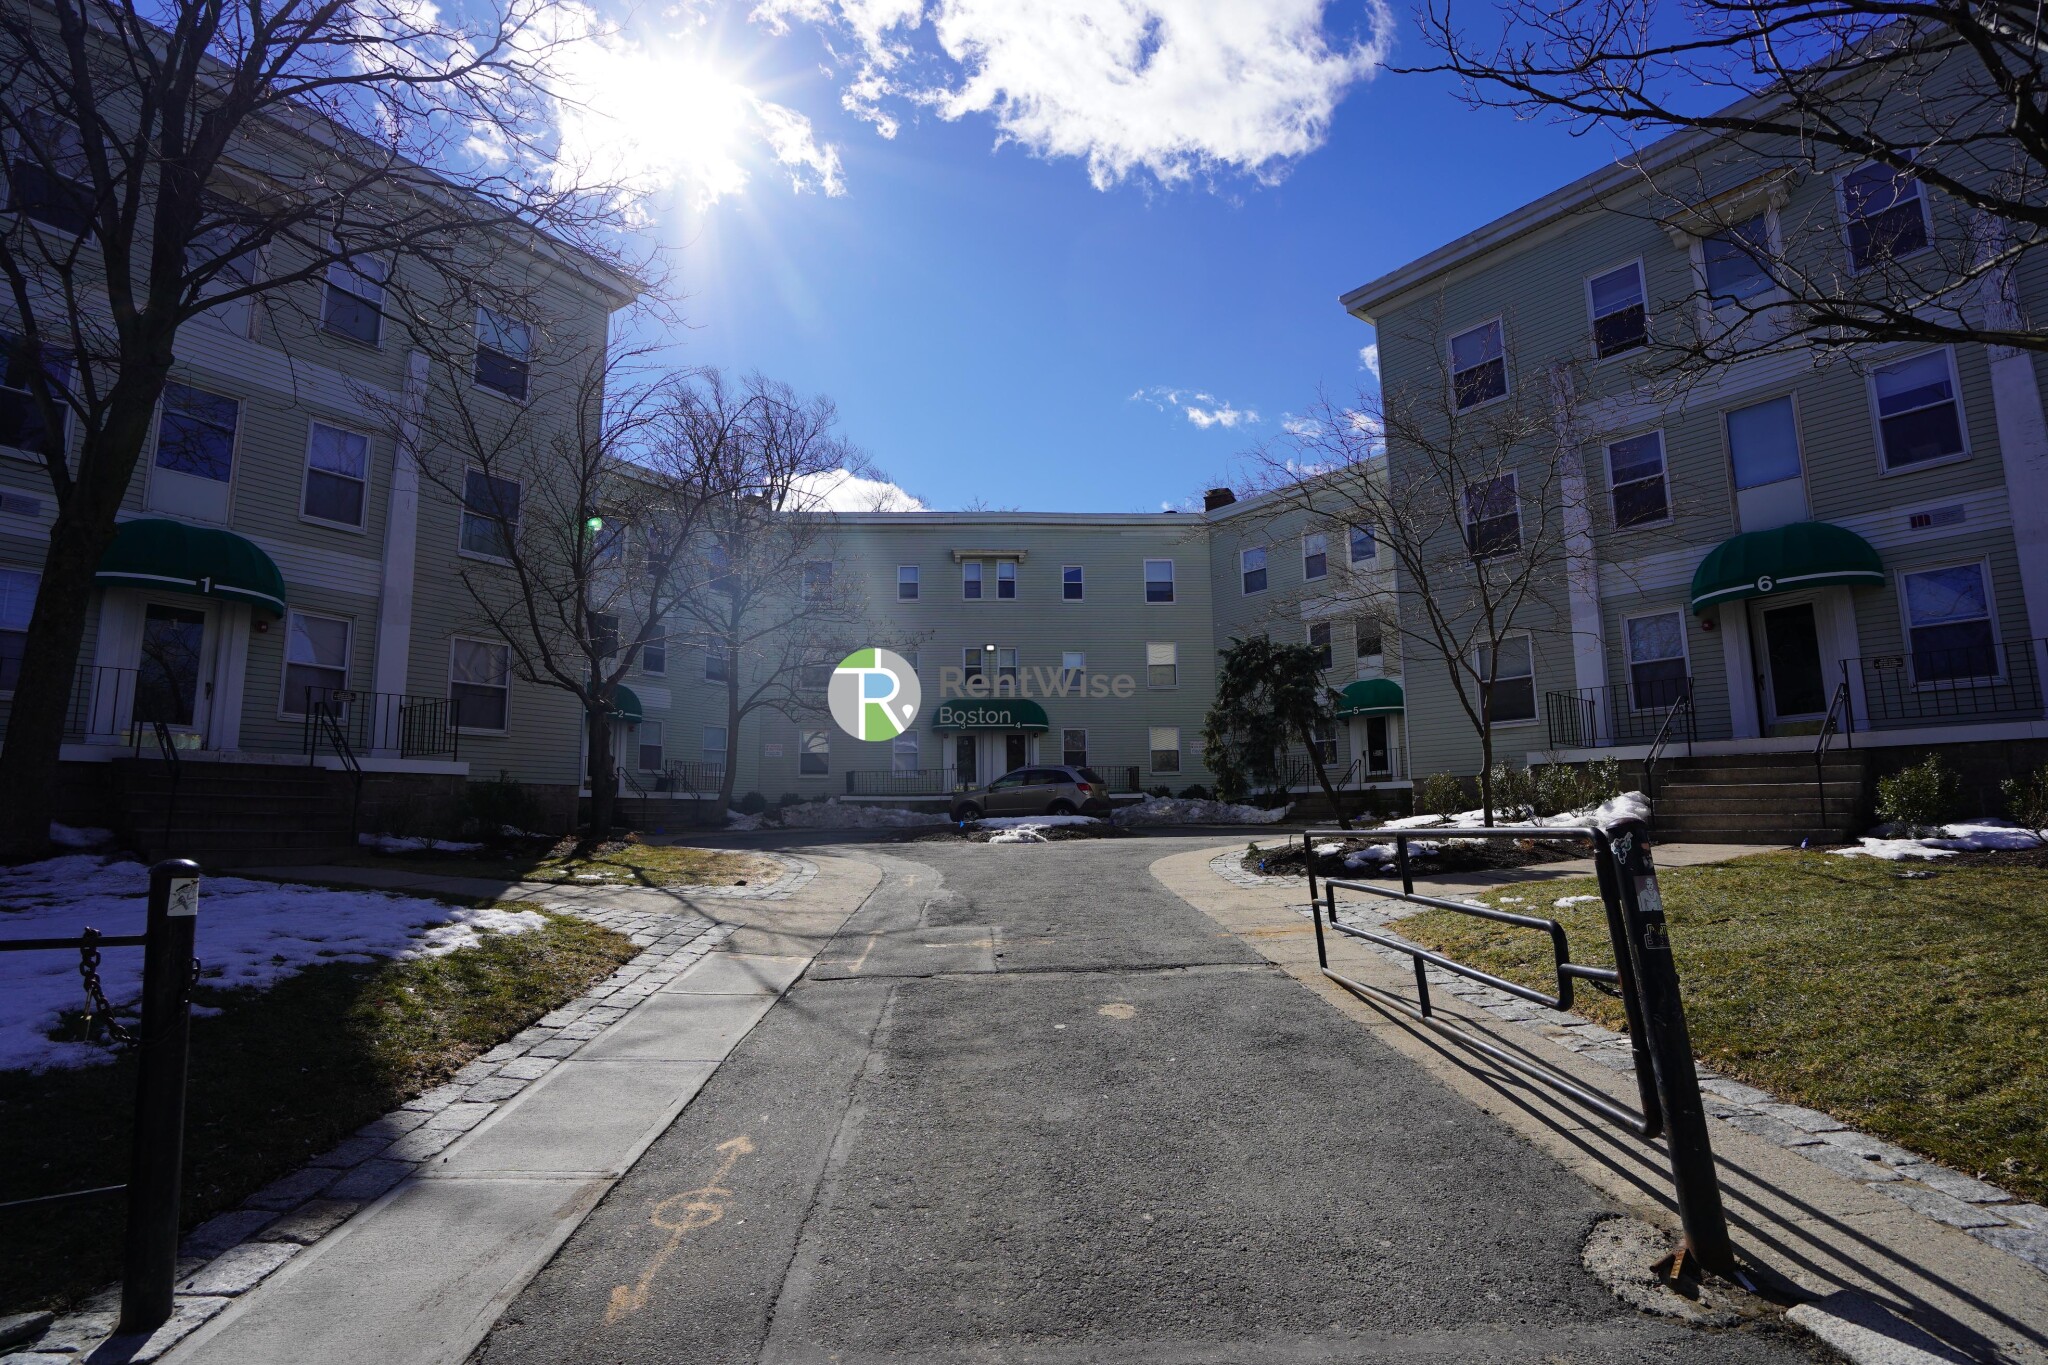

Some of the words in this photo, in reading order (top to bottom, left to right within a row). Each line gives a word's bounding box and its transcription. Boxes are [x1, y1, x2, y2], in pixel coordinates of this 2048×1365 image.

[200, 576, 211, 593] 1
[1757, 576, 1773, 592] 6
[618, 709, 624, 718] 2
[1353, 706, 1359, 714] 5
[960, 721, 966, 729] 3
[1015, 721, 1022, 729] 4
